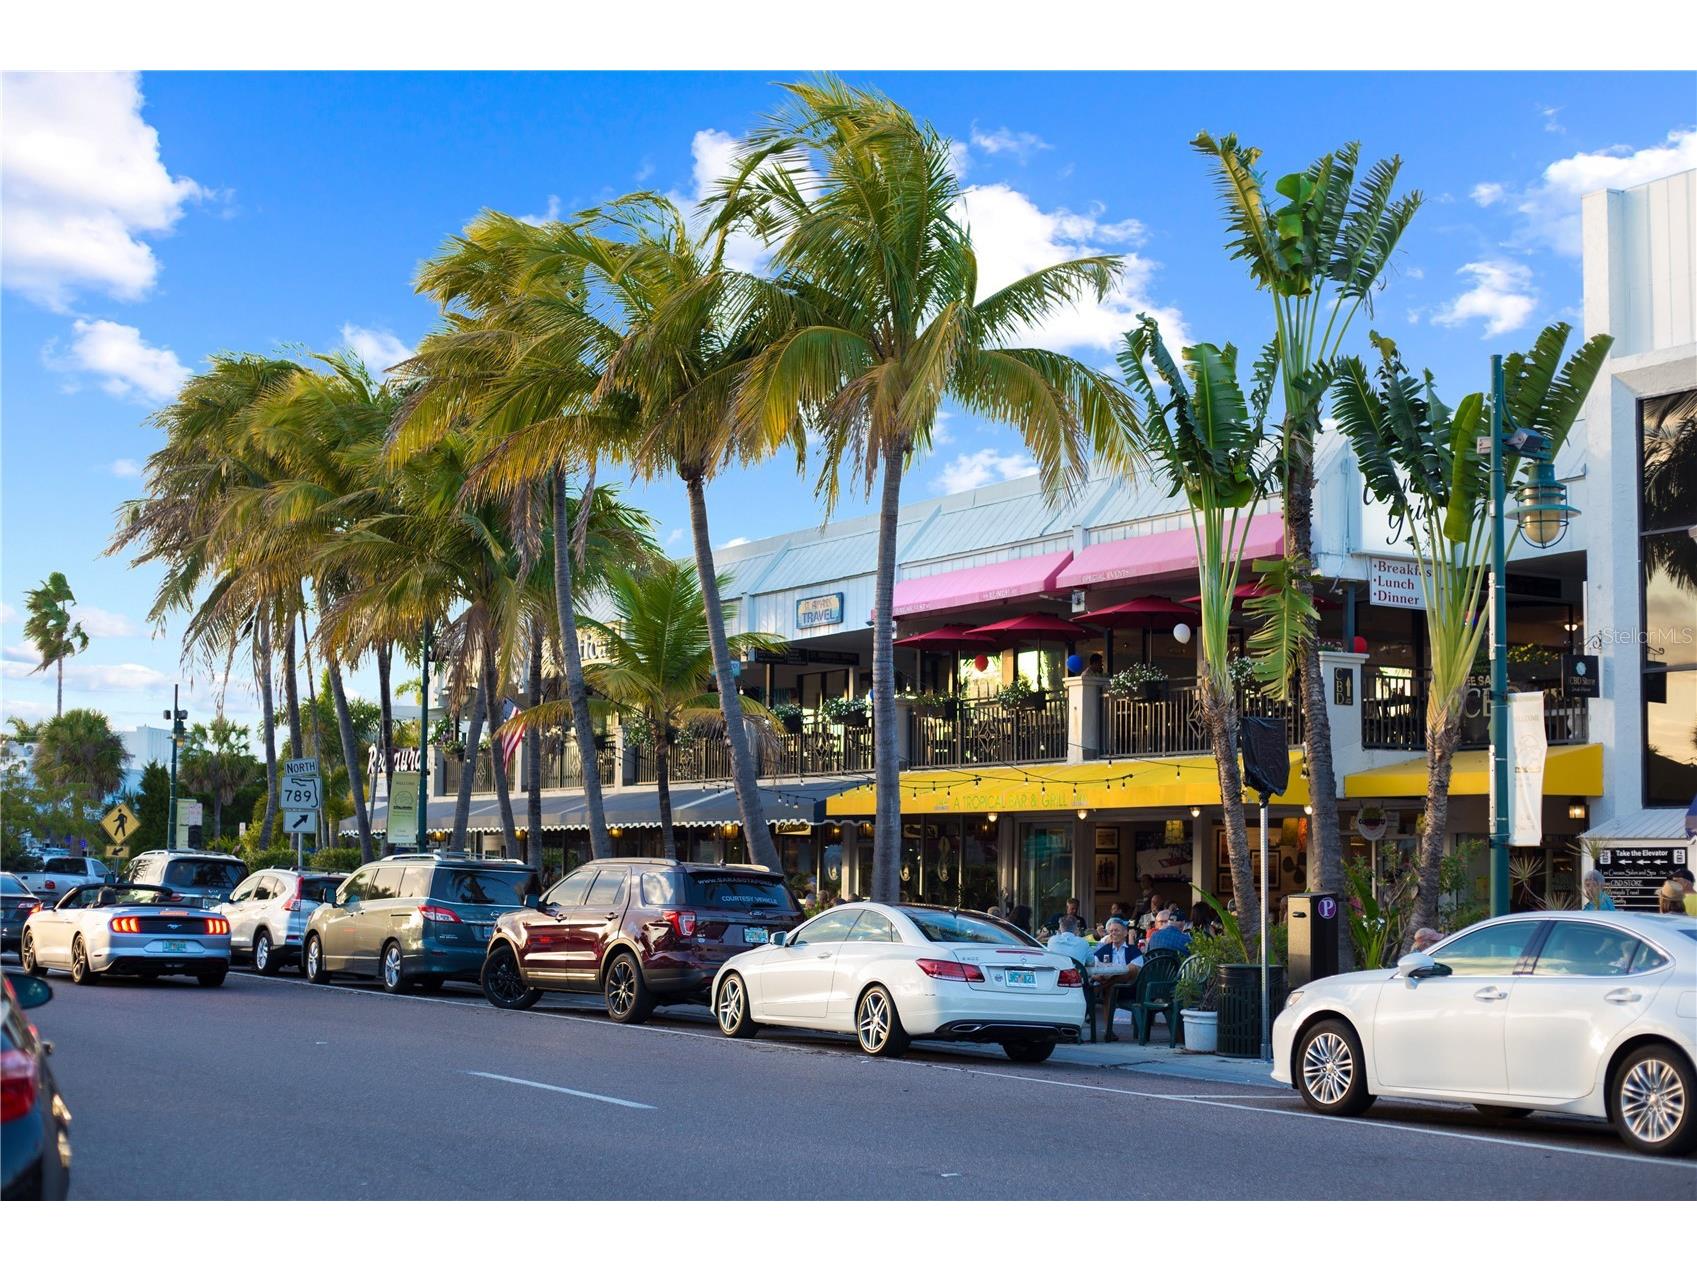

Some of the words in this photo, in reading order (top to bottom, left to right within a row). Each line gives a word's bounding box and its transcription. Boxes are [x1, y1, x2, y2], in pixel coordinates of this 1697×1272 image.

[1378, 560, 1432, 577] Breakfs
[1378, 576, 1414, 590] Lunch
[1378, 590, 1419, 605] Dinner
[802, 608, 835, 624] TRAVEL
[286, 762, 316, 774] NORTH
[284, 789, 312, 802] 789
[953, 797, 960, 809] A
[962, 794, 1006, 809] TROPICAL
[1041, 791, 1068, 807] GRILL
[1616, 849, 1631, 857] Take
[1631, 849, 1641, 857] the
[1642, 849, 1668, 857] Elevator
[754, 896, 778, 904] VEHICLE
